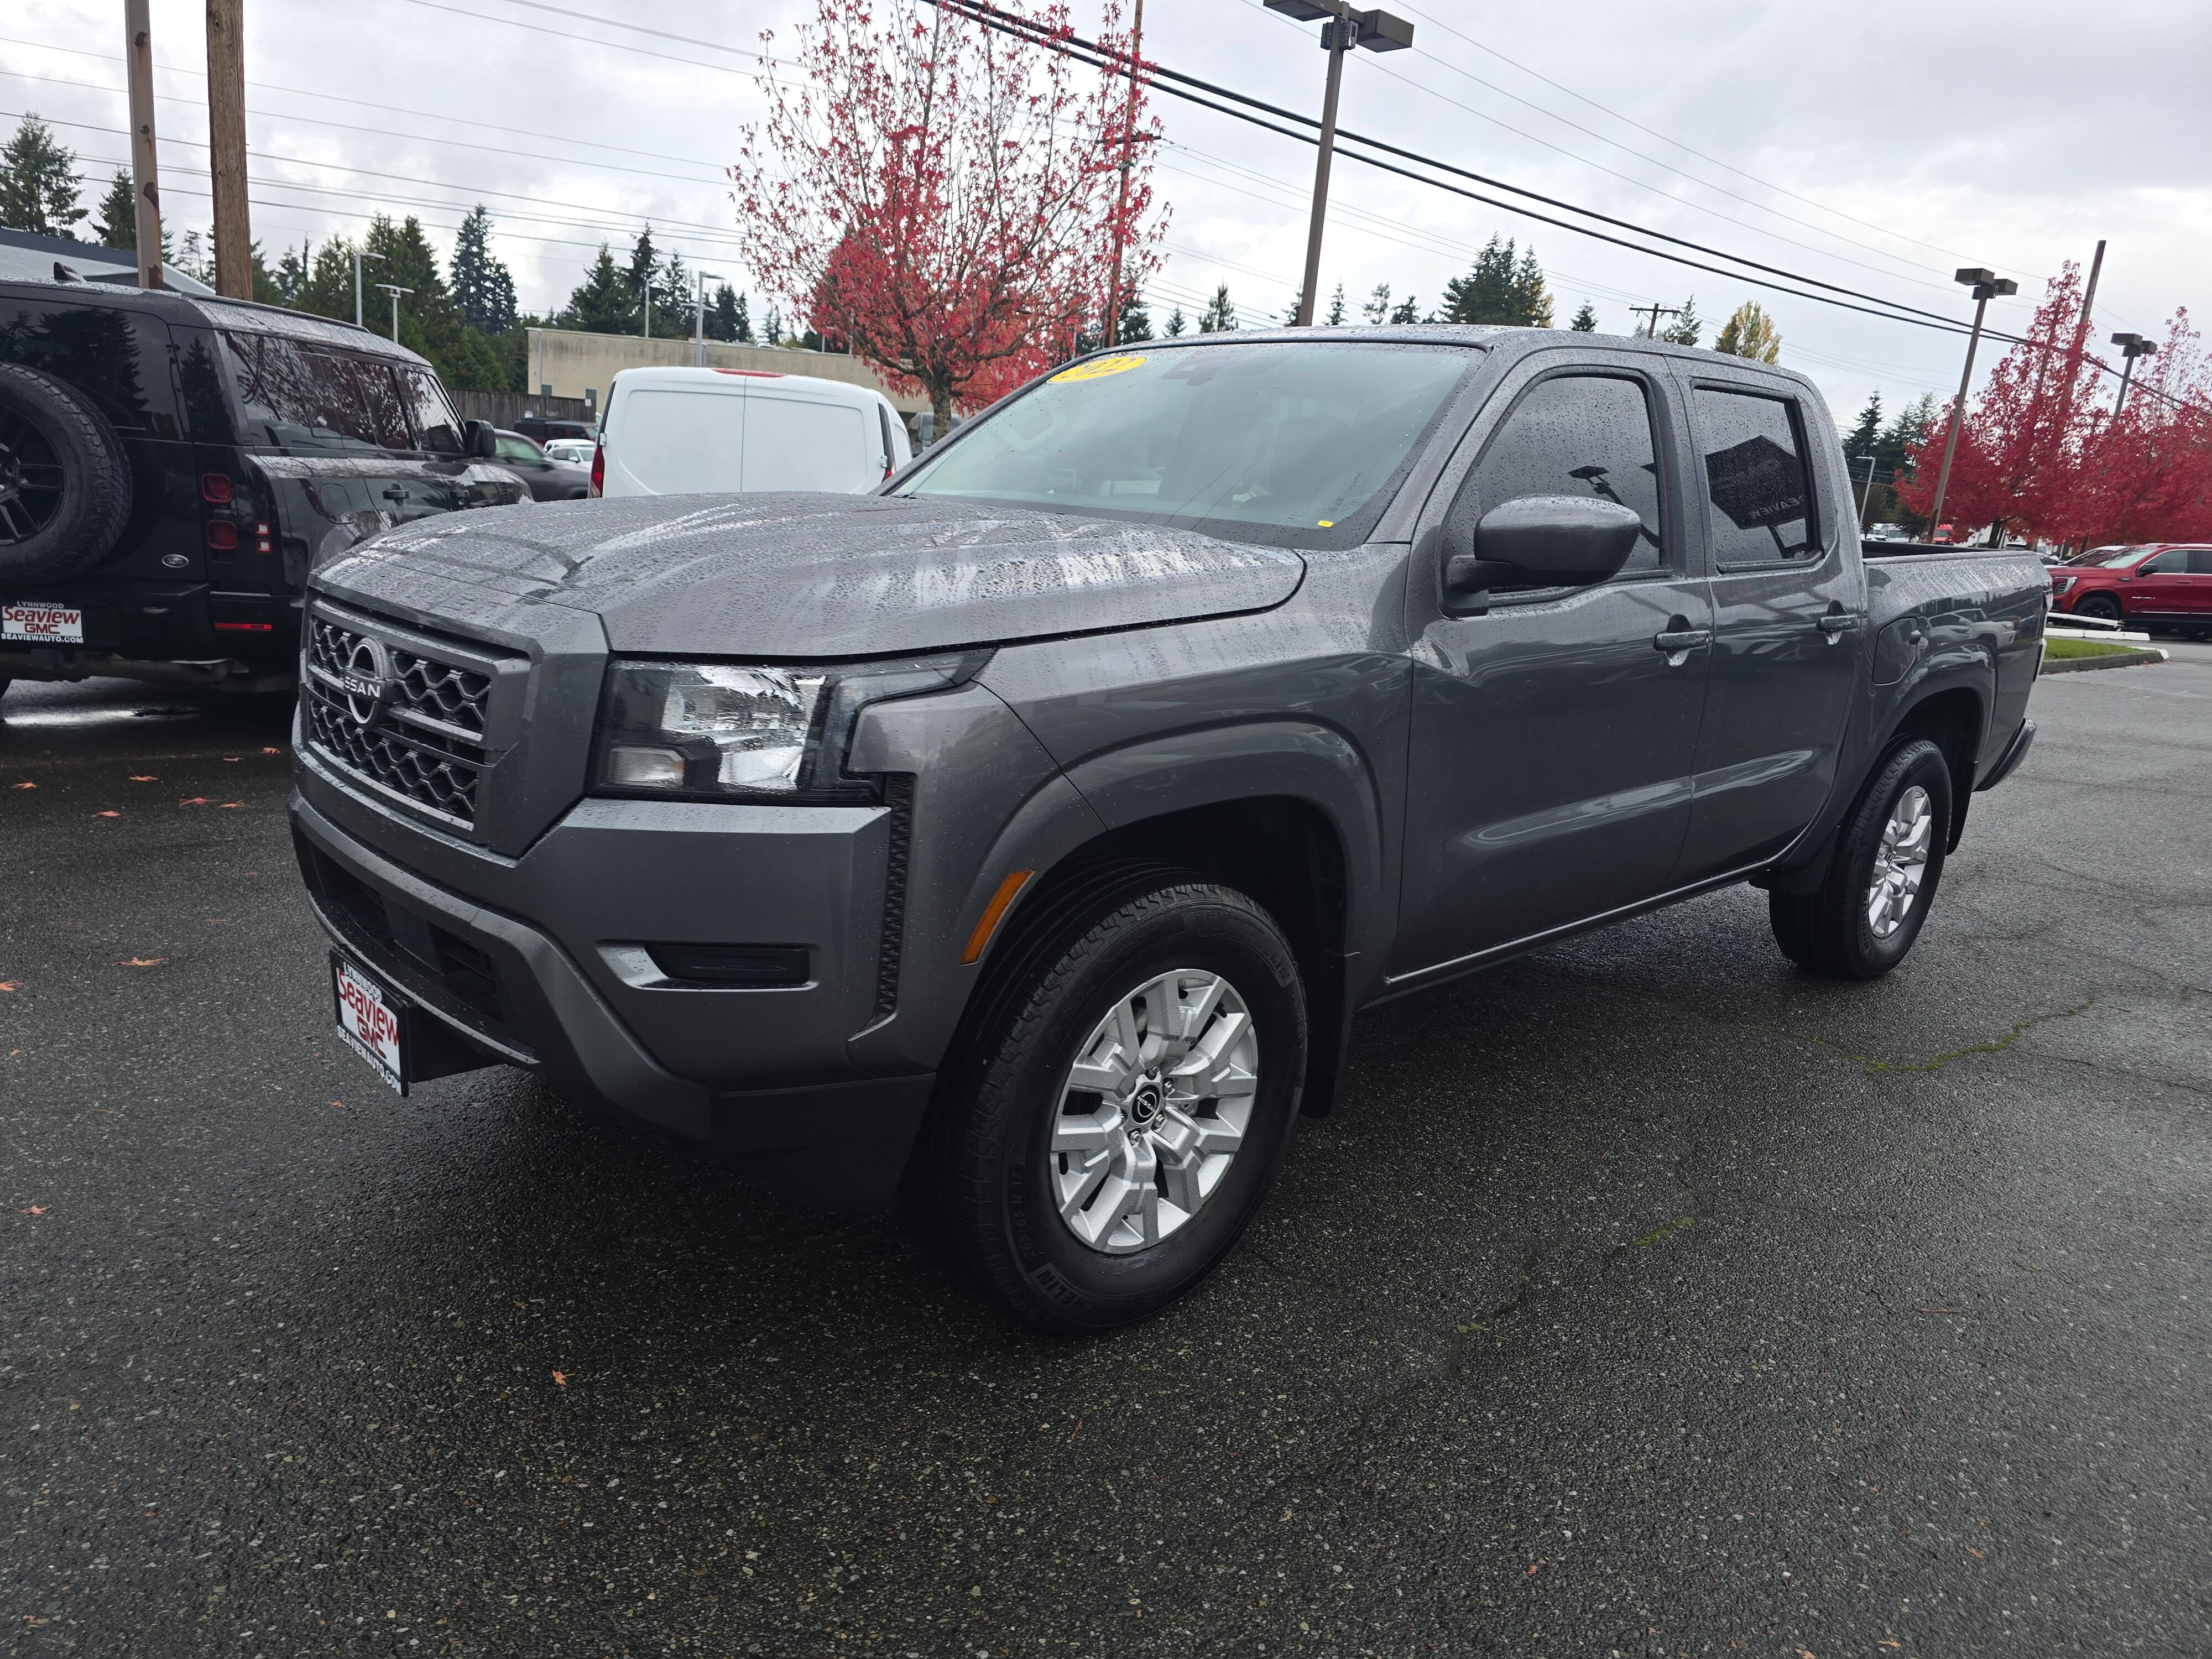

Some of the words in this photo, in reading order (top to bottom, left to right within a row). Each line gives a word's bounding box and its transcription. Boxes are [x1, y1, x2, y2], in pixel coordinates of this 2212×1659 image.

[17, 601, 64, 609] LYNNWOOD
[3, 606, 80, 624] Seaview
[24, 623, 60, 634] GMC
[1, 633, 84, 644] SEAVIEWAUTO.COM
[345, 676, 380, 698] SSAN
[338, 968, 399, 1046] Seaview
[357, 1014, 387, 1060] GMC
[336, 1025, 402, 1095] SEAVIEWAUTO.COM
[1136, 1095, 1156, 1113] NISSAN
[1012, 1194, 1023, 1204] R
[1013, 1210, 1036, 1259] 265/65
